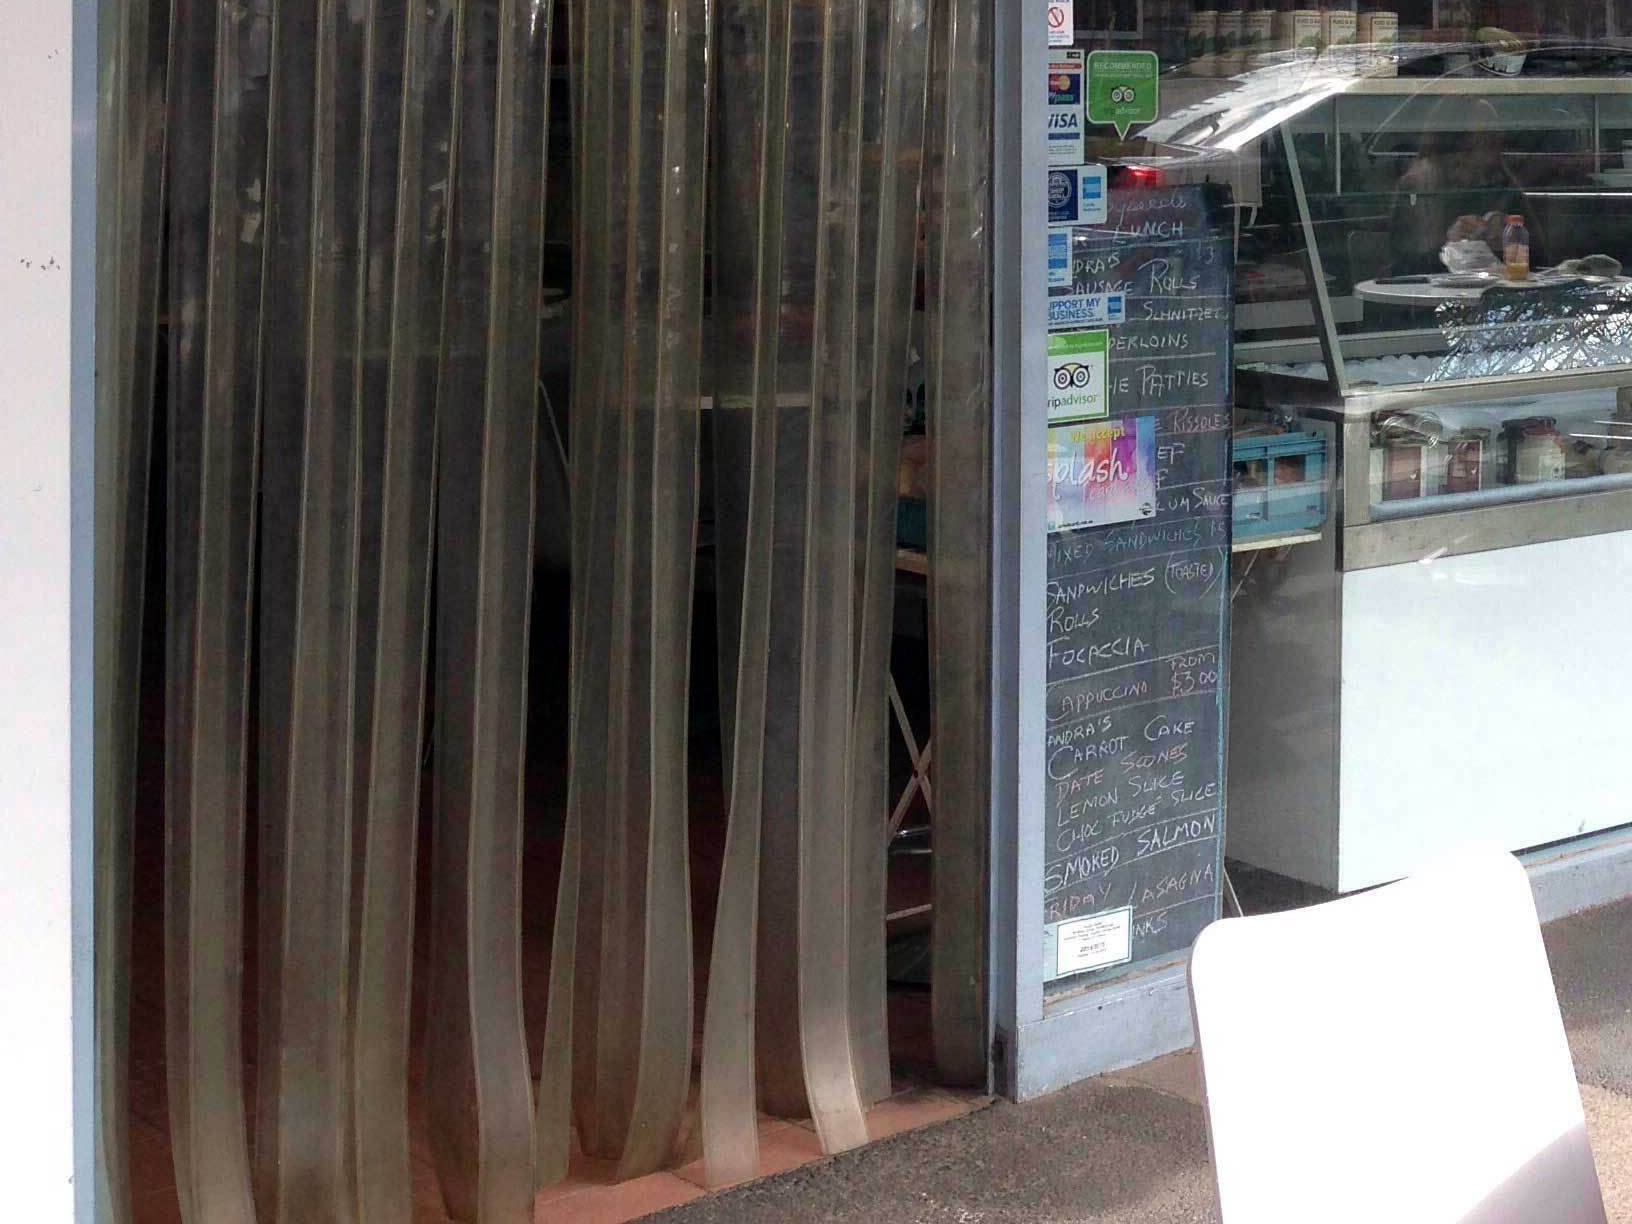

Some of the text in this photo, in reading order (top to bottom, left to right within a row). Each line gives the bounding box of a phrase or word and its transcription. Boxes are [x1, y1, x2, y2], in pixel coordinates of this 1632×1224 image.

[1048, 297, 1101, 311] UPPORT MY
[1048, 392, 1097, 410] ripadvisor
[1048, 606, 1101, 634] ROLLS
[1047, 636, 1150, 671] FOCACCIA
[1048, 714, 1113, 747] ANDRA'S
[1143, 714, 1196, 742] CAKE
[1056, 770, 1185, 827] LEMON SLICE
[1170, 782, 1217, 807] SLICE
[1044, 813, 1216, 894] SMOKED SALMON
[1049, 882, 1112, 921] RIDAY
